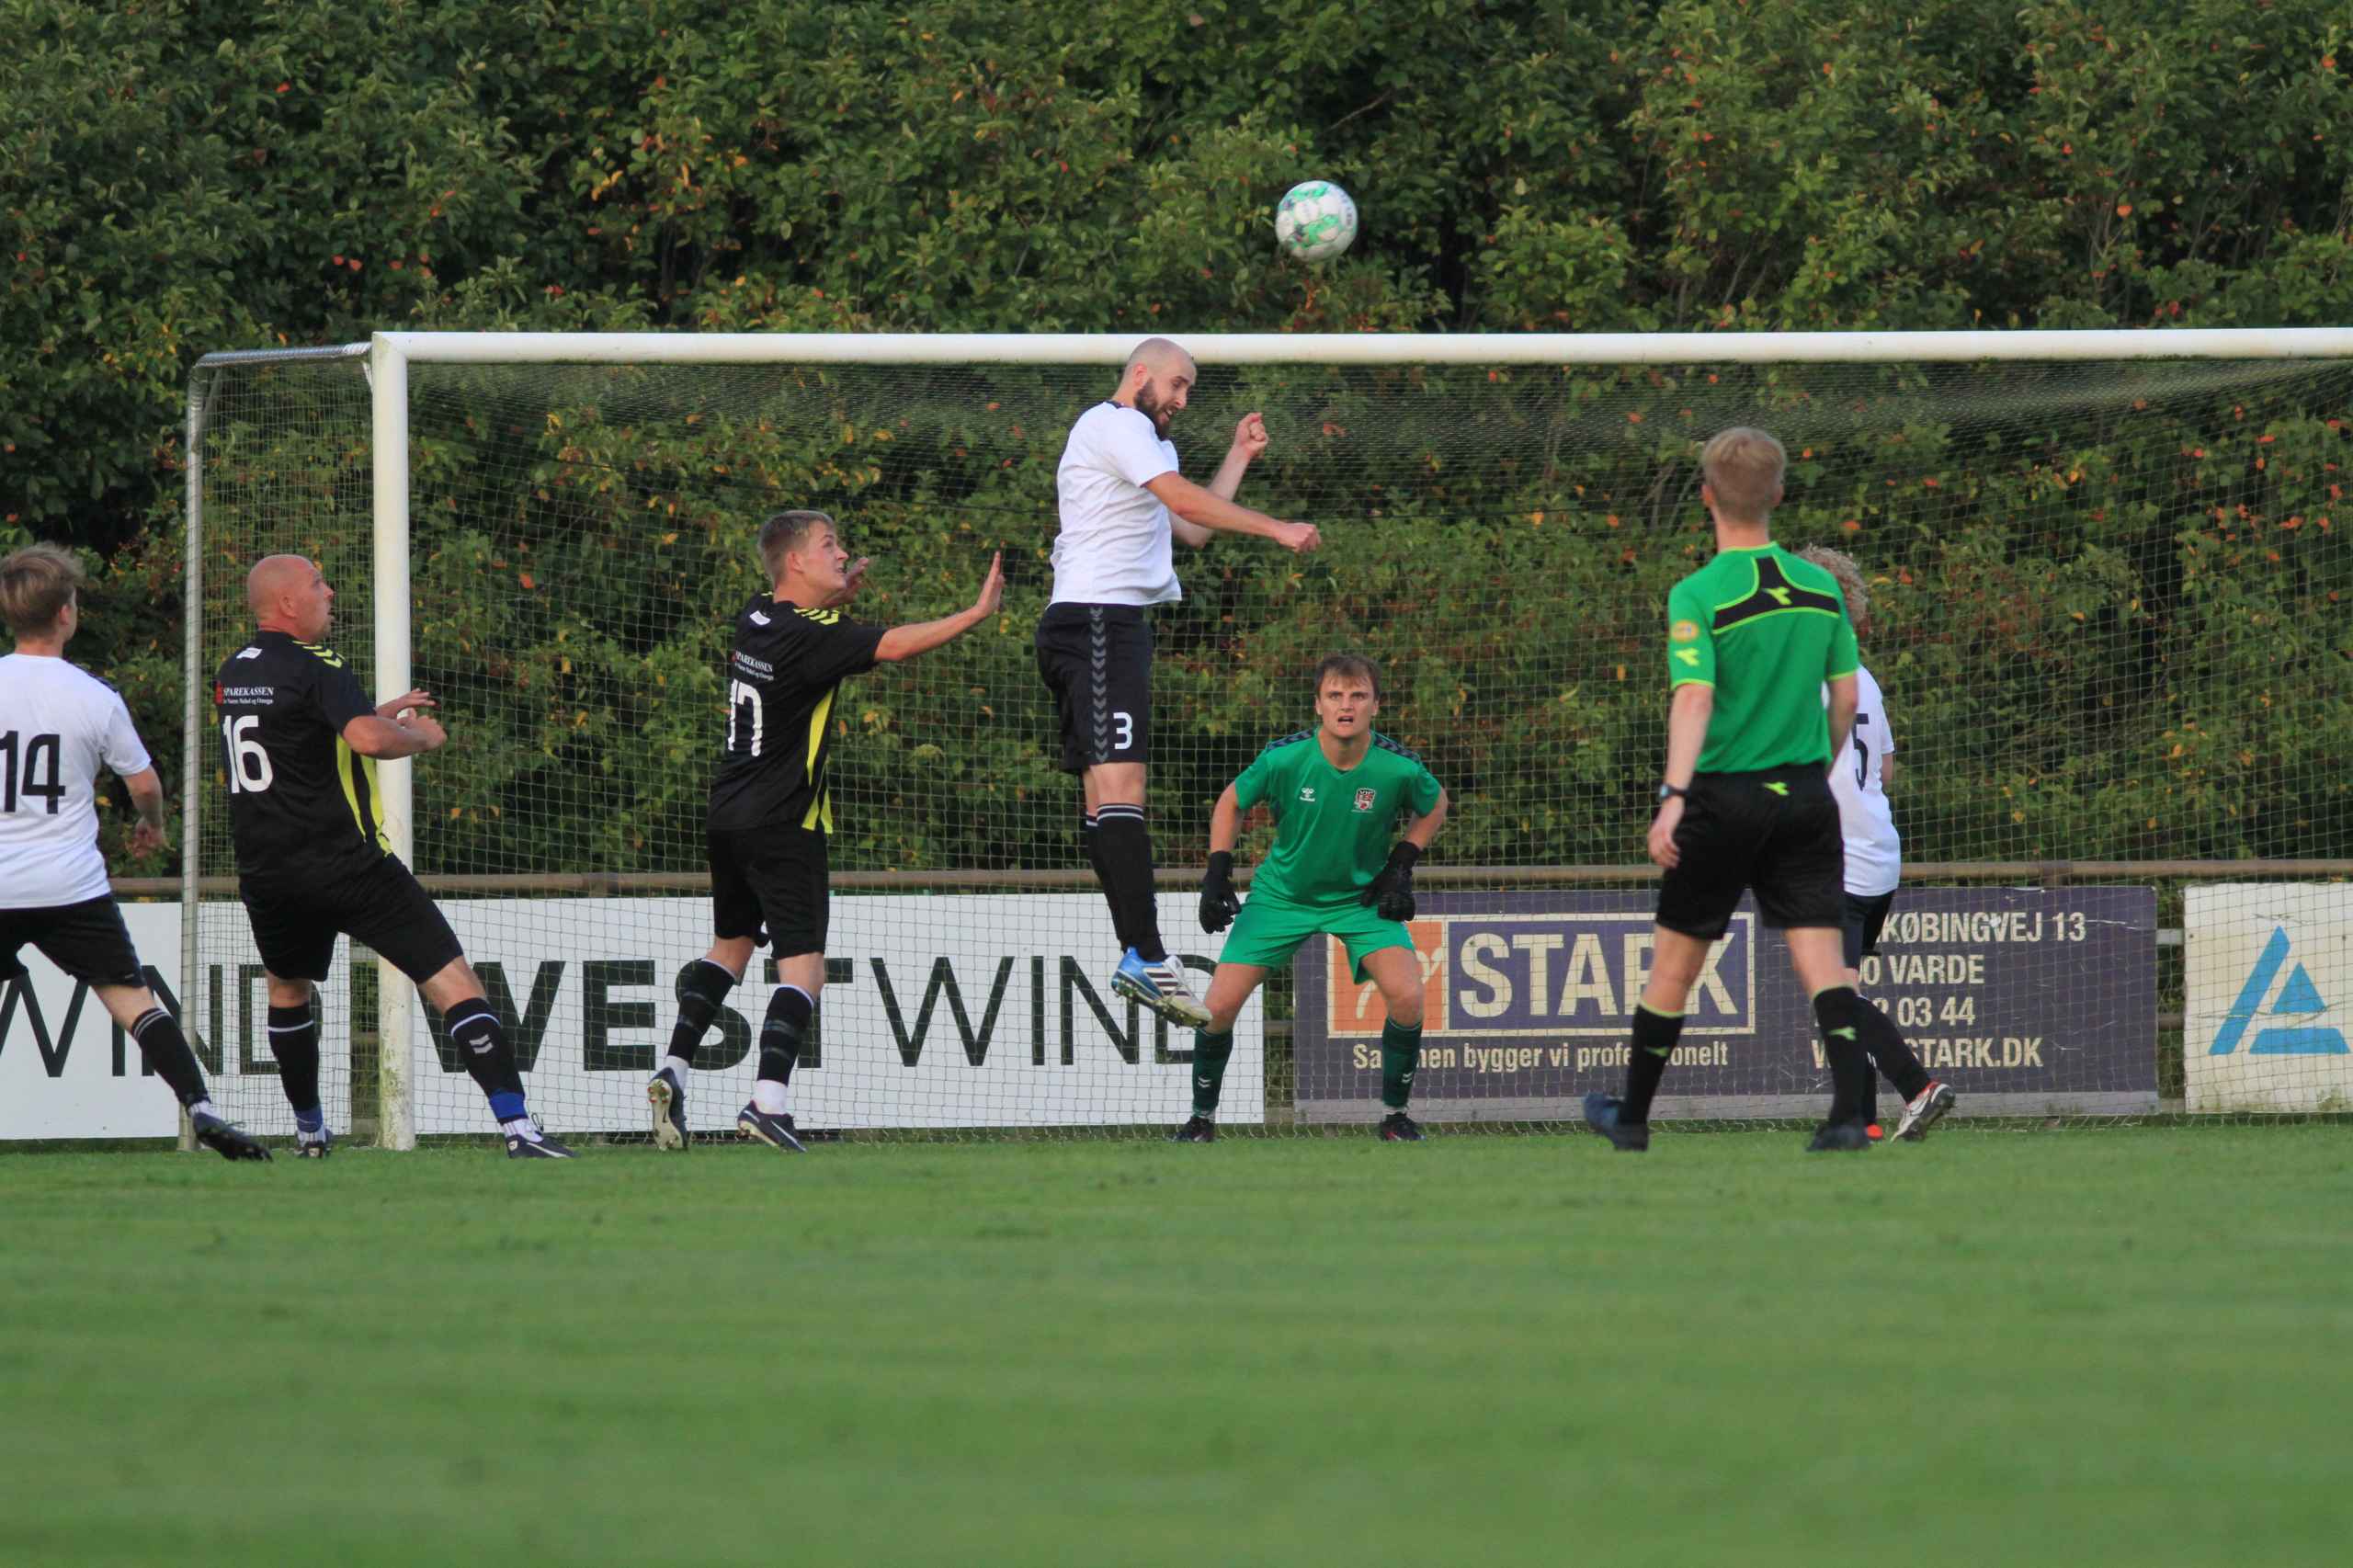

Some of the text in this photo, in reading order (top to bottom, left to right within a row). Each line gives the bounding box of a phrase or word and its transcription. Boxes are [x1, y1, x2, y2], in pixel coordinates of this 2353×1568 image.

[728, 678, 763, 756] 17
[1113, 712, 1133, 750] 3
[222, 715, 273, 793] 16
[1851, 713, 1870, 791] 5
[0, 730, 66, 814] 14
[1876, 912, 2086, 944] KØBINGVEJ 13
[1888, 955, 1985, 985] VARDE
[1897, 996, 1933, 1027] 03
[1939, 996, 1976, 1026] 44
[1353, 1041, 1728, 1074] Saen bygger vi profeonelt
